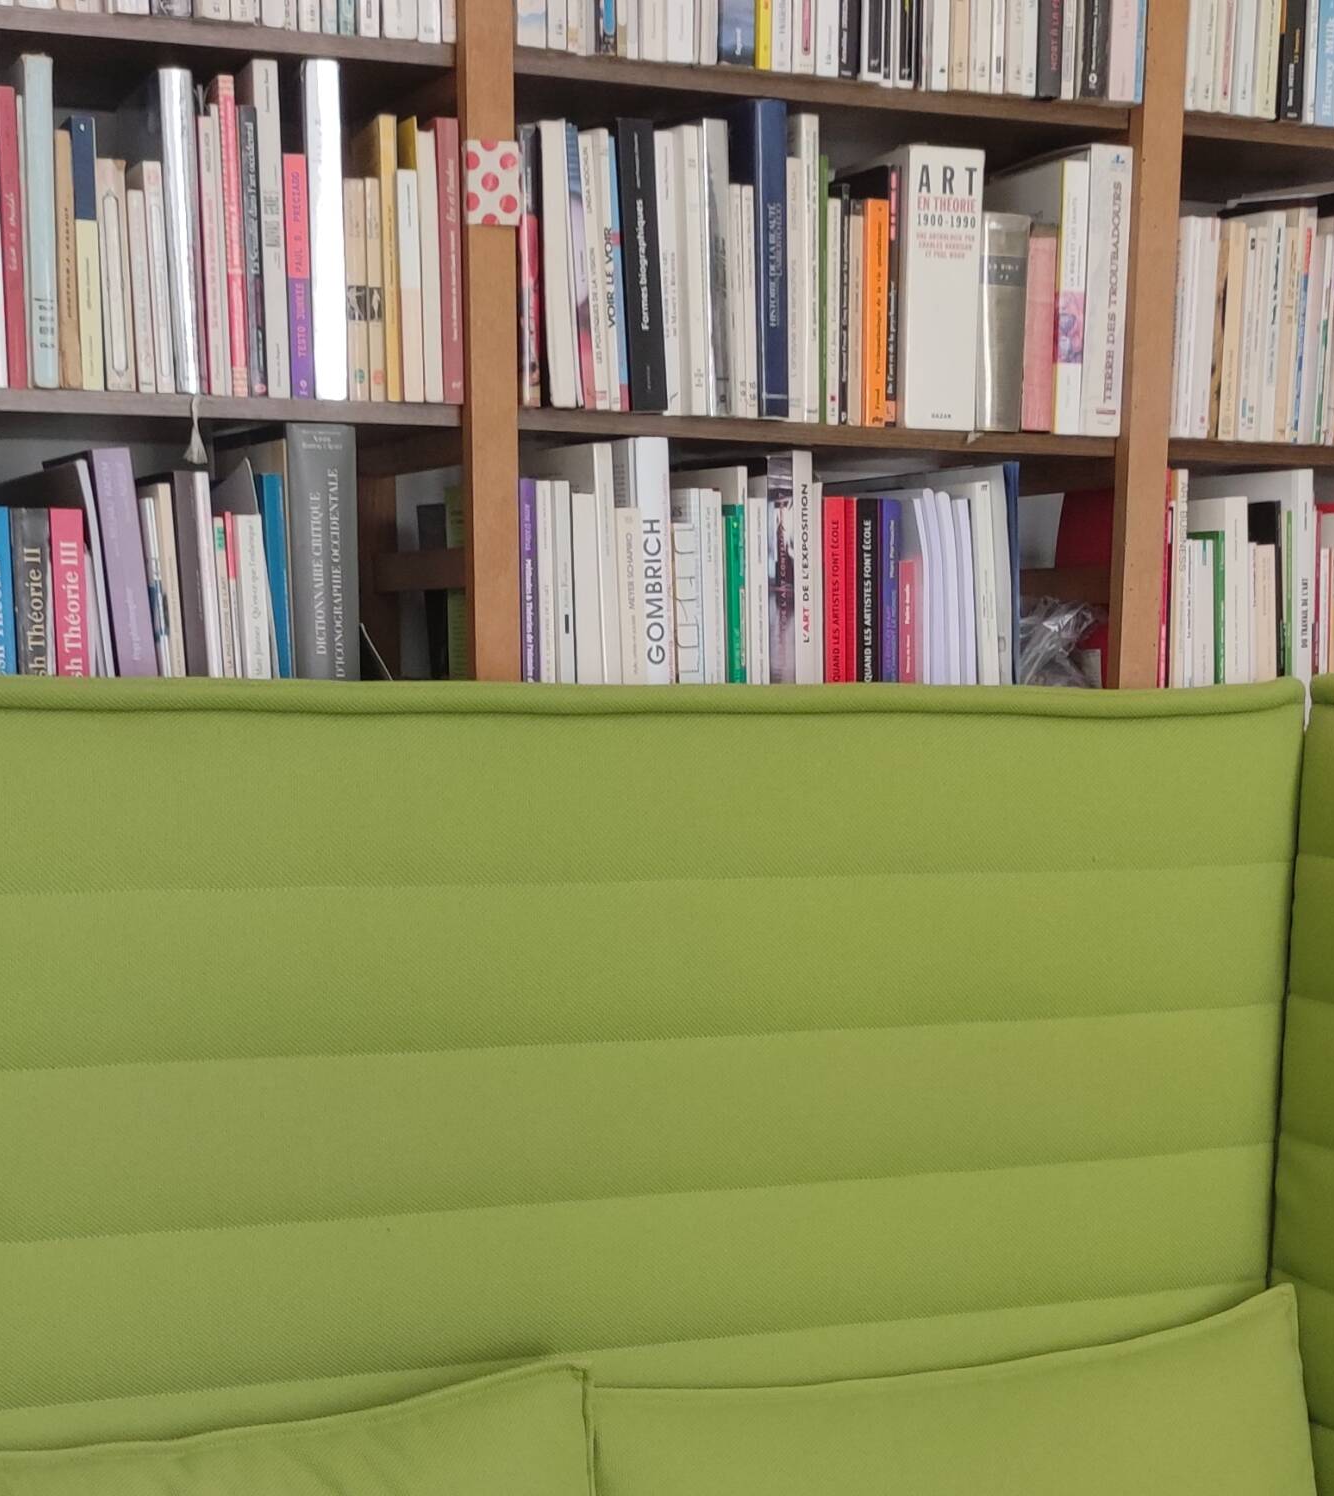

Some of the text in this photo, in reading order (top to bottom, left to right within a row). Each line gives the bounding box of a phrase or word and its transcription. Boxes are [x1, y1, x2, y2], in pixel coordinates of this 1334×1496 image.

[290, 171, 302, 224] PRECIADO
[917, 195, 976, 214] EN THÉORIE
[918, 163, 978, 197] ART
[293, 244, 304, 274] PAUL
[588, 246, 597, 276] VISION
[917, 213, 977, 229] 1900-1990
[603, 226, 617, 328] VOIR LE VOIR
[634, 199, 650, 331] Formes biographiques
[1102, 181, 1122, 404] TERRE DES TROUBADOURS
[294, 282, 307, 359] TESTO JUNKIE
[22, 546, 43, 563] II
[59, 540, 80, 566] III
[308, 491, 328, 656] DICTIONNAIRE CRITIQUE
[326, 467, 347, 679] D'ICONOGRAPHIE OCCIDENTALE
[625, 532, 636, 610] MEYER SCHAPIRO
[642, 518, 666, 665] GOMBRICH
[800, 483, 811, 644] L'ART DE L'EXPOSITION
[26, 567, 47, 649] Théorie
[64, 570, 83, 654] Théorie
[829, 519, 841, 683] QUAND LES ARTISTES FONT ÉCOLE
[861, 520, 873, 683] QUAND LES ARTISTES FONT ÉCOLE
[1300, 577, 1309, 649] DU TRAVAIL DE L'ART
